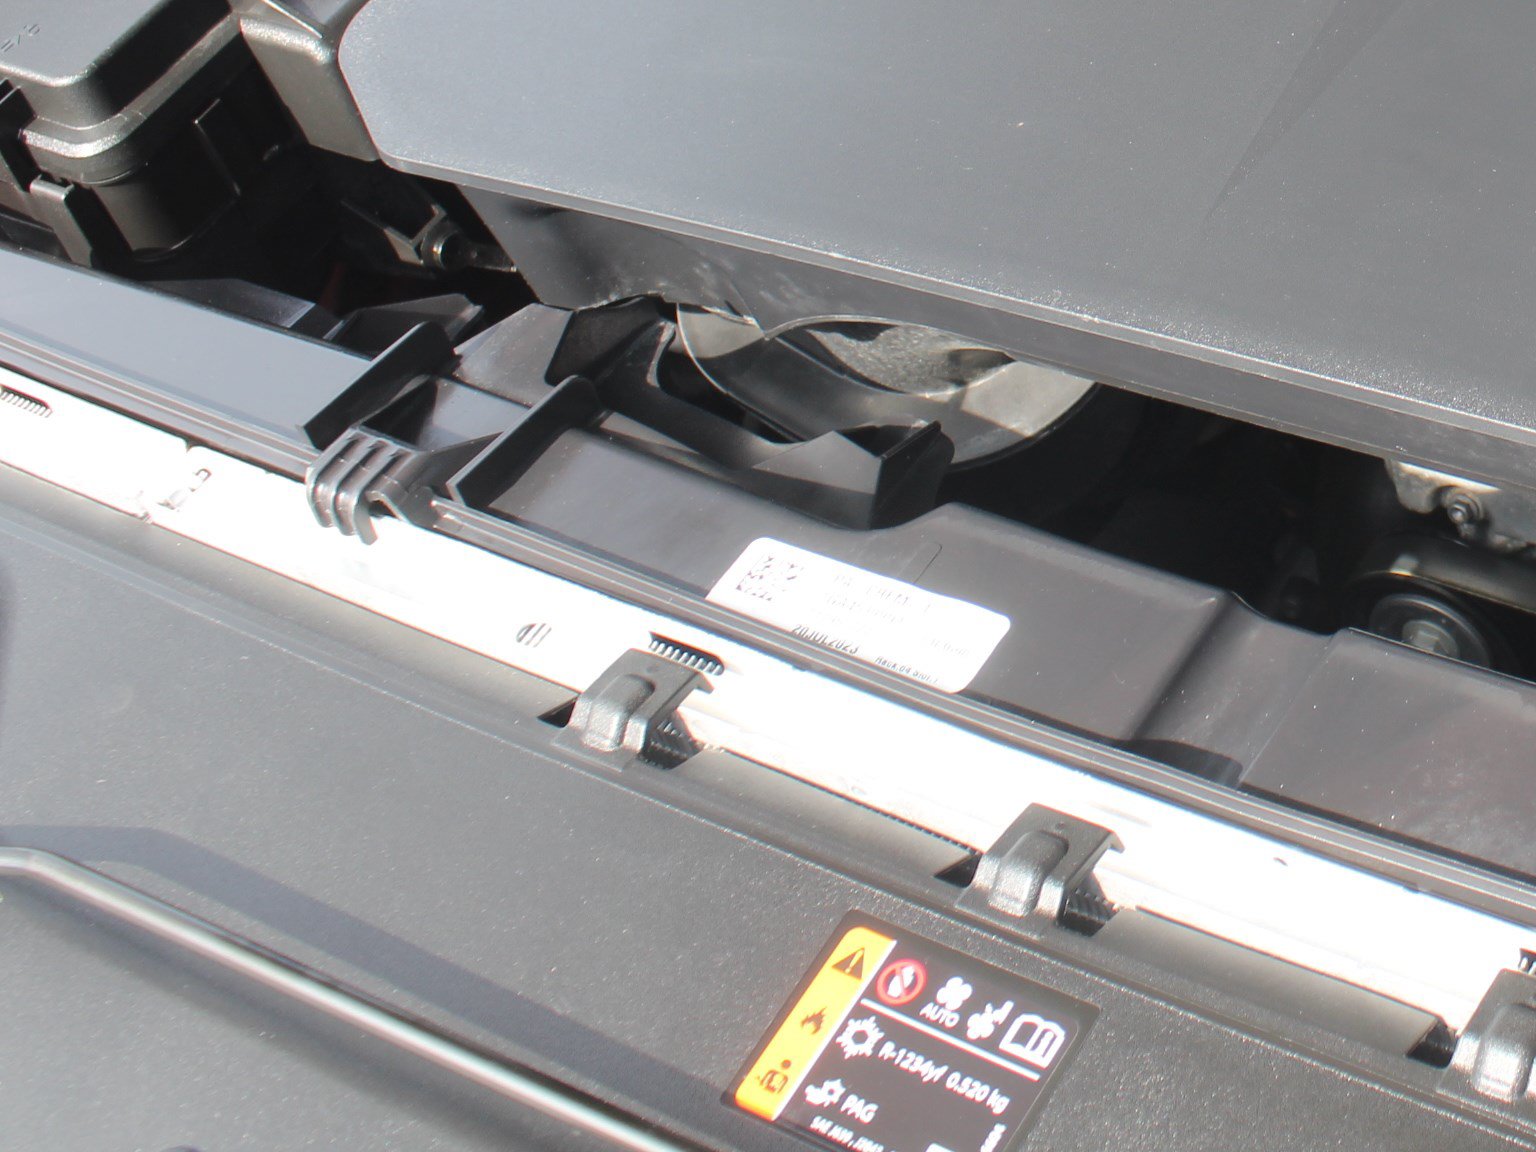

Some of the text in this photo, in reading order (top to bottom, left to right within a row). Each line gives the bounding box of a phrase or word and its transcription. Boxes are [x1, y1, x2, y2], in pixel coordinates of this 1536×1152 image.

[920, 1002, 960, 1028] AUTO
[878, 1041, 948, 1083] R-1234yf
[986, 1088, 1010, 1115] kg
[841, 1094, 878, 1124] PAG
